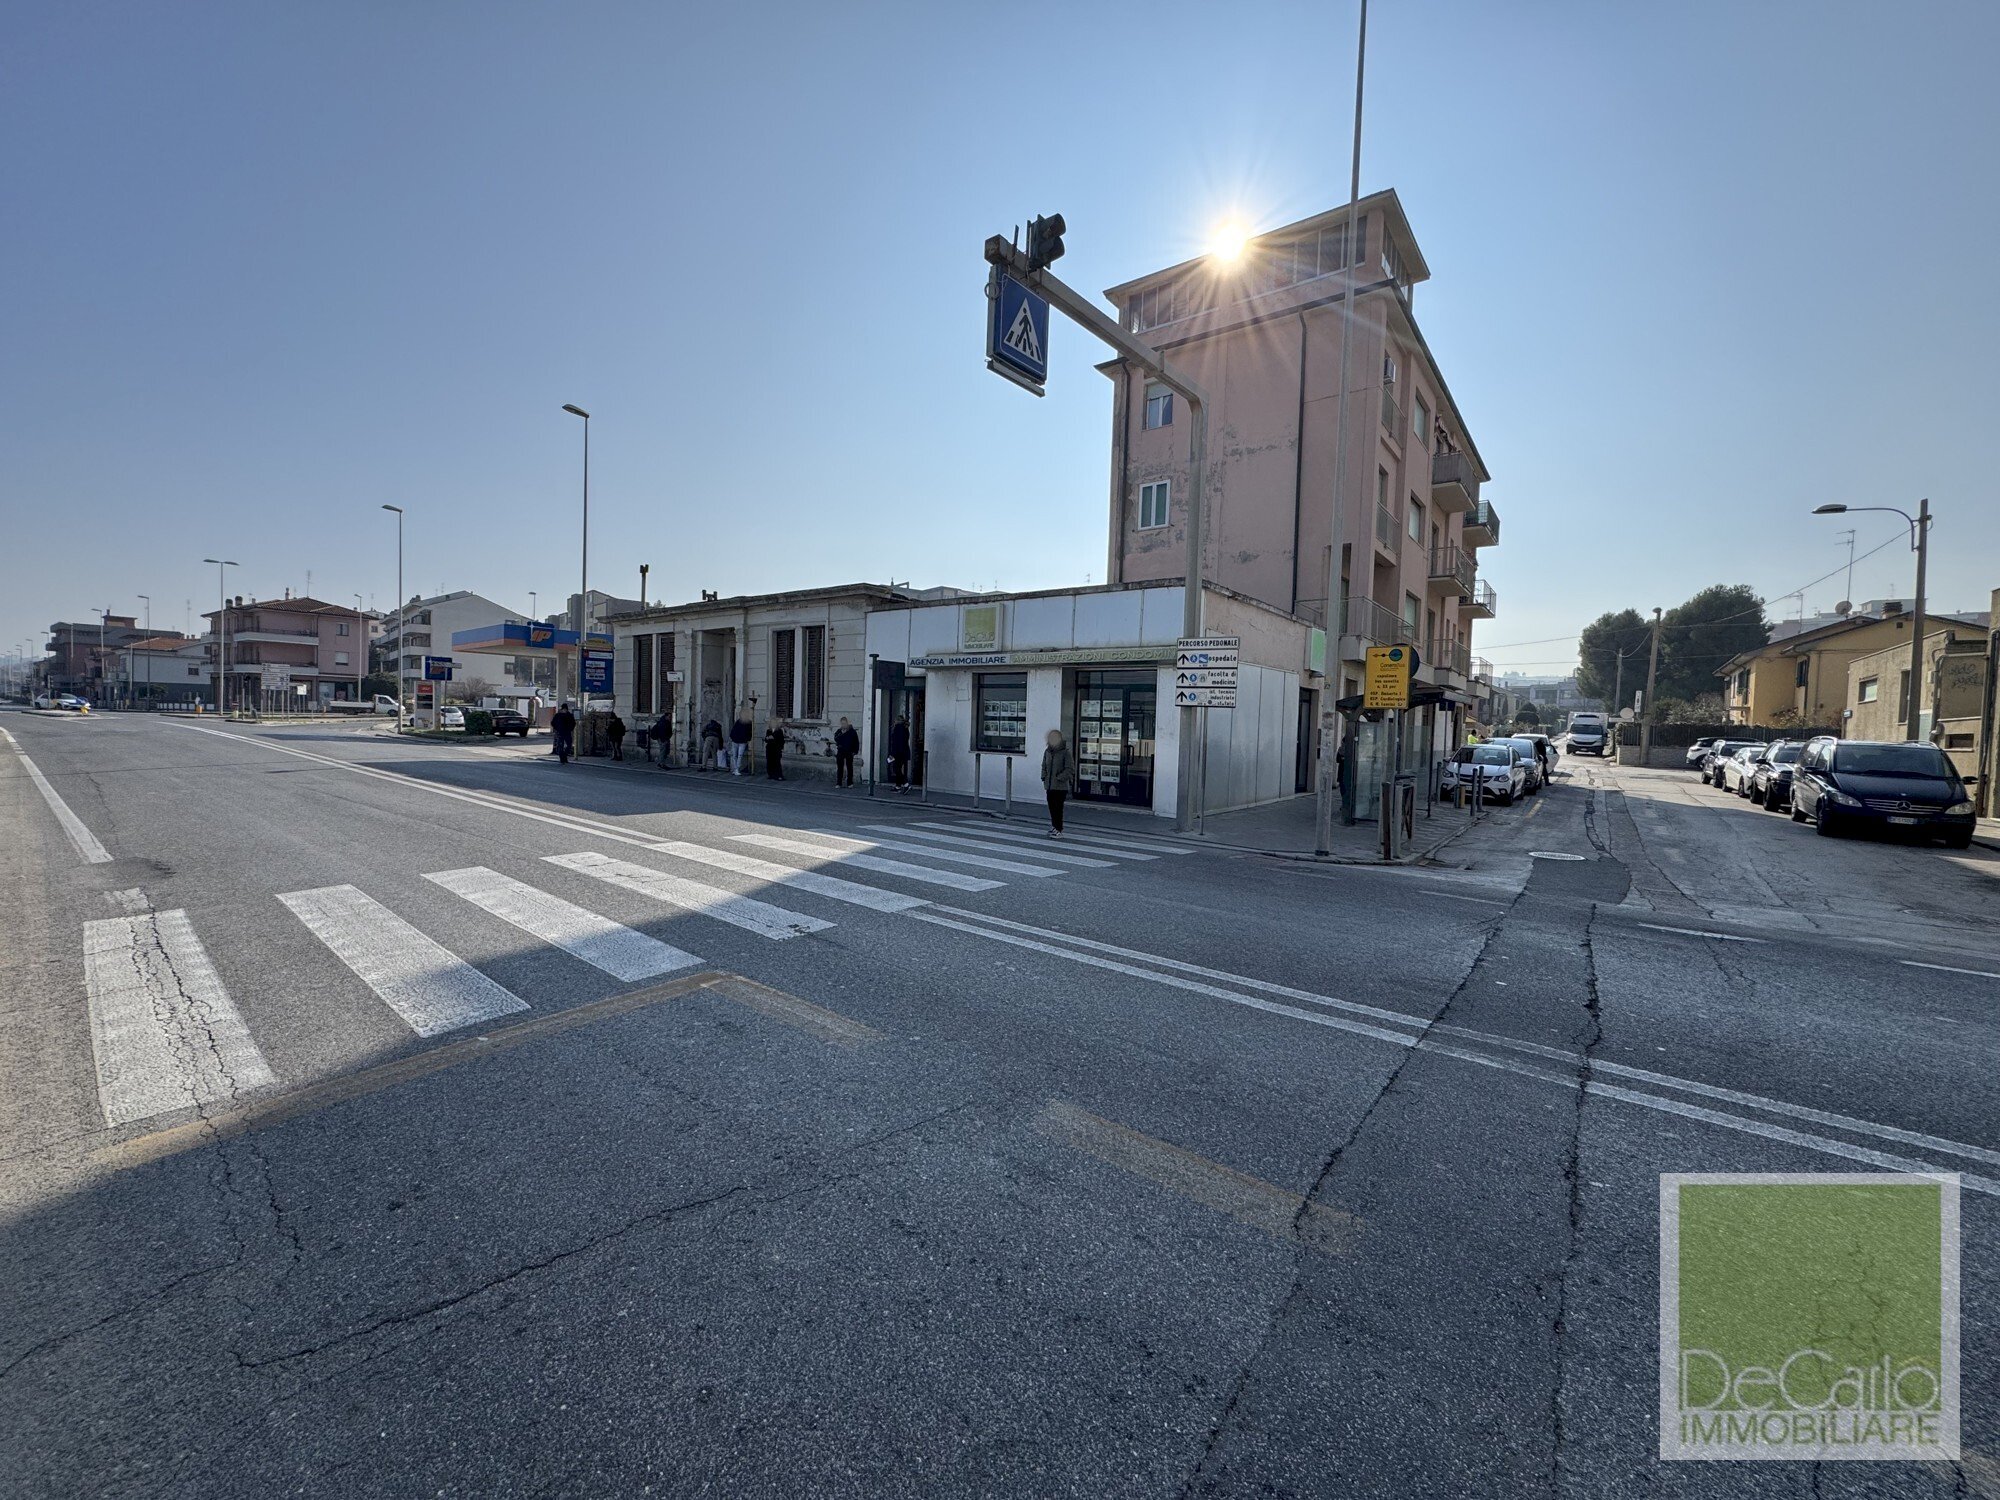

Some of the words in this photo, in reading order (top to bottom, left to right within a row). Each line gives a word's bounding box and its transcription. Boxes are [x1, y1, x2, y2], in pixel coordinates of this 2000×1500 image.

[910, 658, 944, 666] AGENZIA
[949, 656, 1006, 664] IMMOBILIARE
[1013, 652, 1104, 662] AMMINISTRAZIONI
